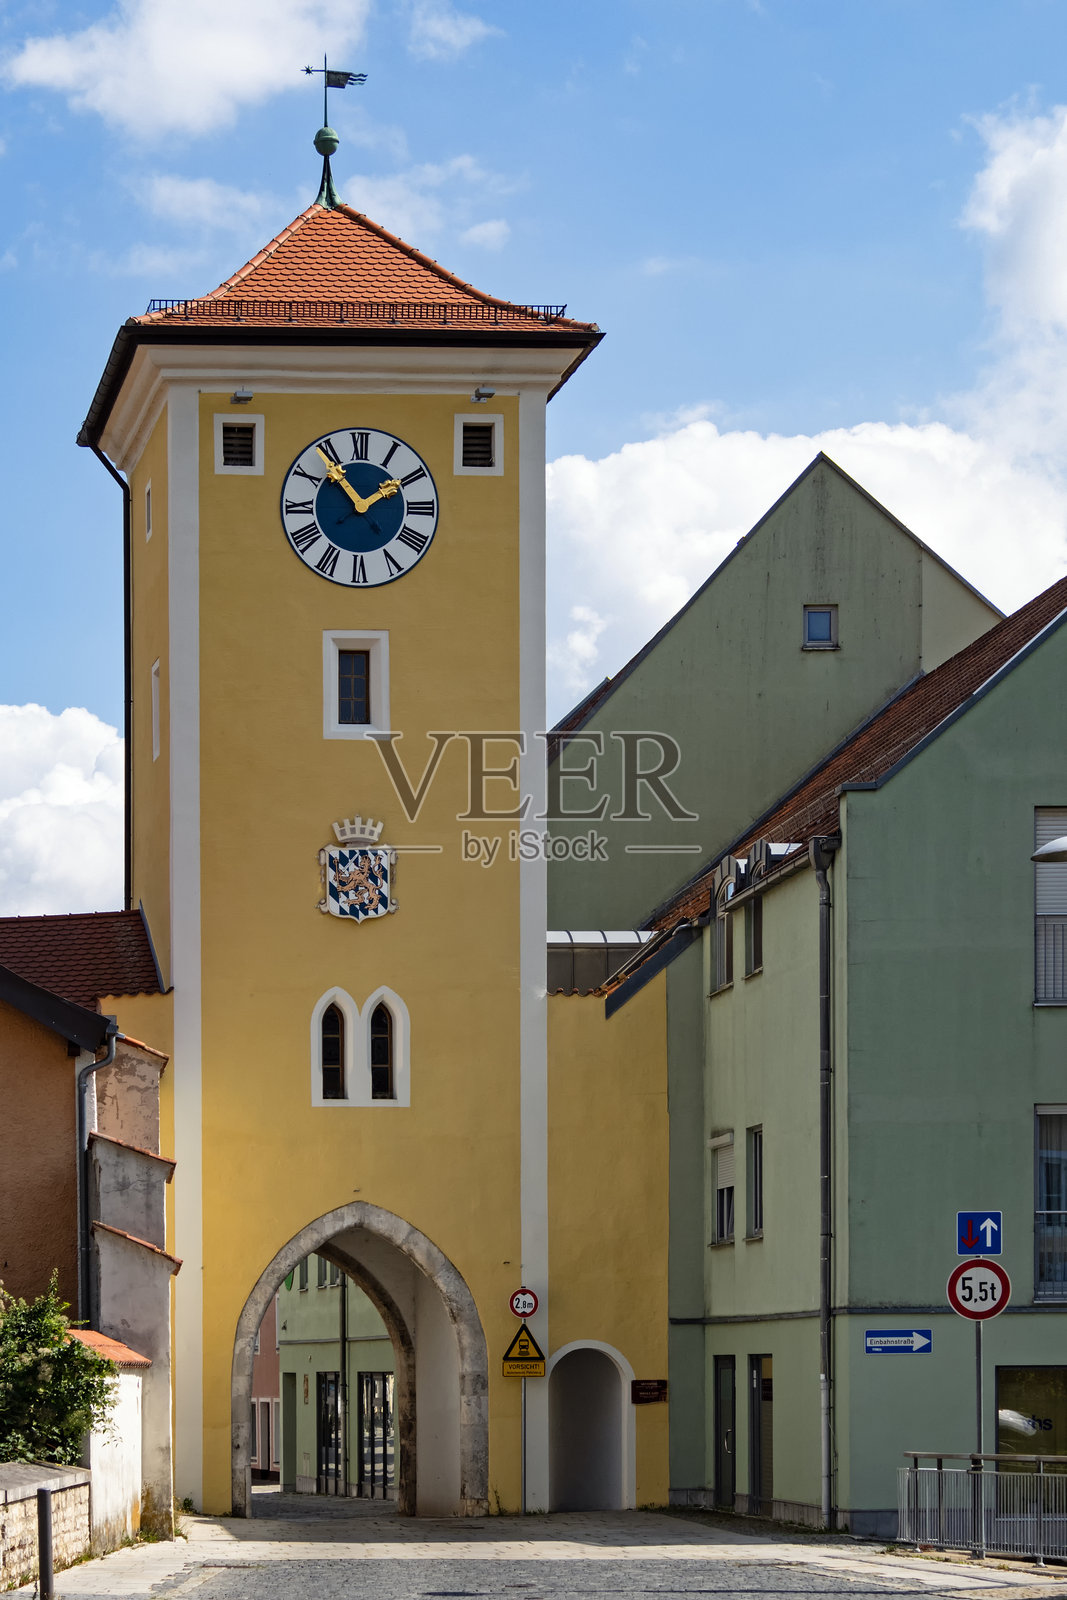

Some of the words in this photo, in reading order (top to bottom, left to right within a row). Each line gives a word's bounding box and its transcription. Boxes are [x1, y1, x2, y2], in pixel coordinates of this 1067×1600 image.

[350, 432, 371, 461] XII
[380, 440, 401, 469] I
[292, 464, 323, 488] X
[400, 465, 428, 489] II
[285, 498, 314, 516] IX
[406, 499, 435, 518] III
[290, 520, 323, 555] VIII
[396, 523, 429, 555] IIII
[314, 543, 341, 577] VII
[351, 554, 368, 583] VI
[383, 548, 404, 577] V
[869, 1338, 915, 1346] Einbahnstraße
